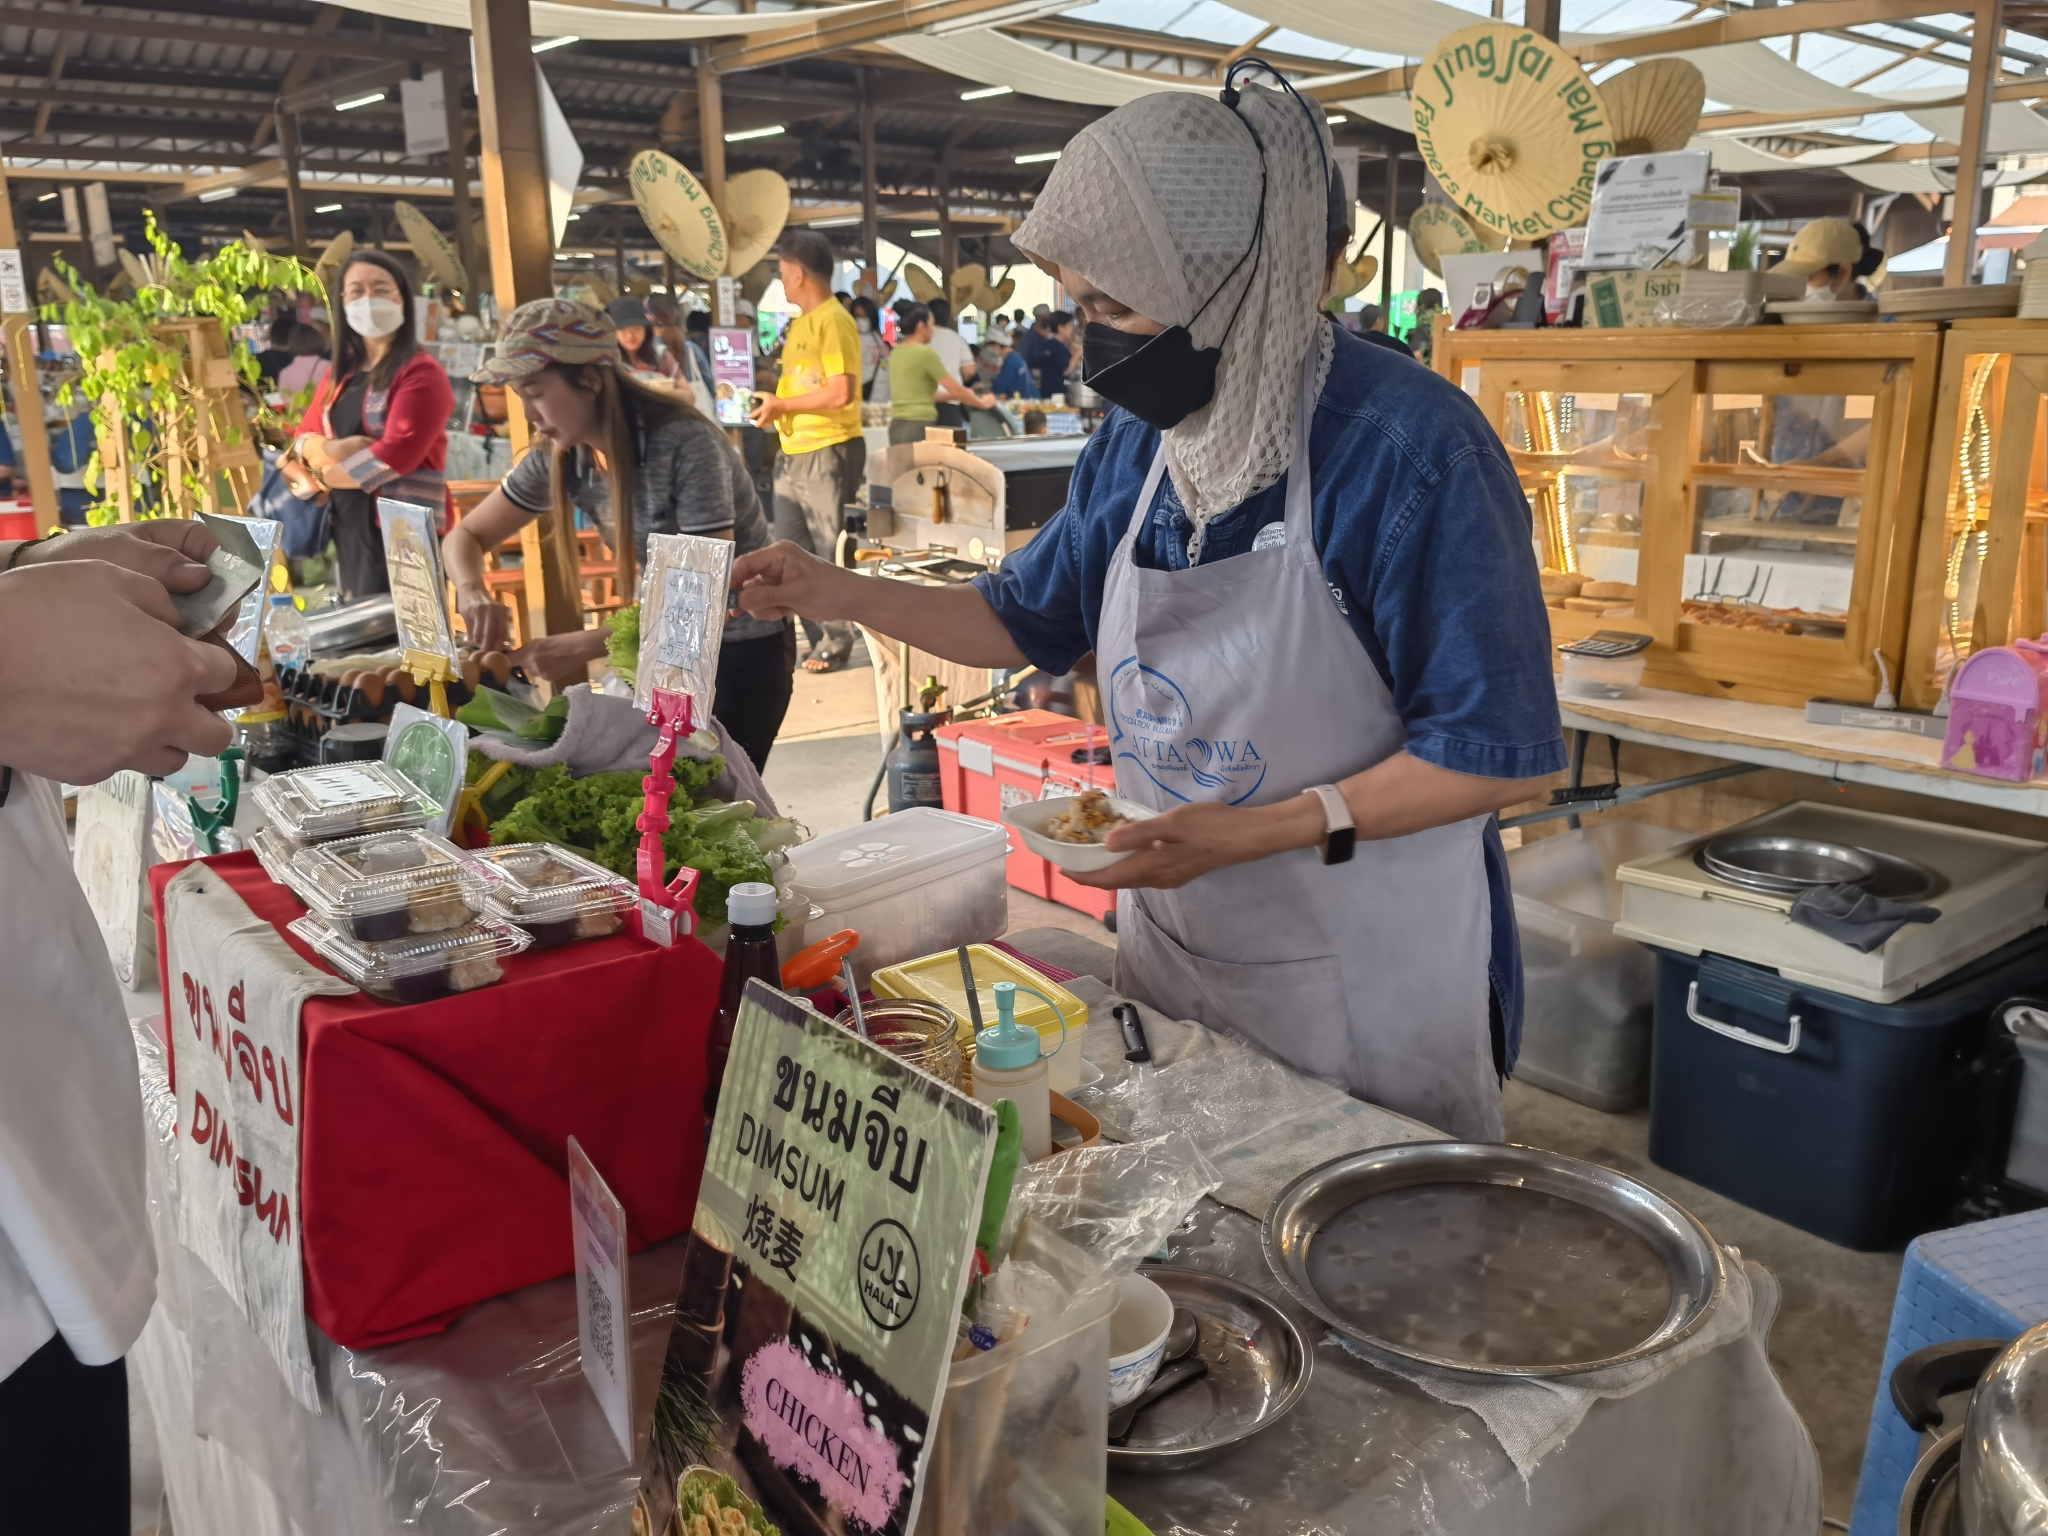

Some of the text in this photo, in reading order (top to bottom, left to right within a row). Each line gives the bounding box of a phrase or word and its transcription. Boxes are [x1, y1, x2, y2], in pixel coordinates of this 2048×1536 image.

[674, 170, 700, 202] Mai
[1414, 76, 1613, 236] Farmers Market Chiang Mai
[735, 1111, 846, 1224] DIMSUM
[772, 1054, 928, 1195] ขนมจีบ
[741, 1194, 805, 1284] 烧麦
[863, 1237, 913, 1301] حلال
[864, 1279, 902, 1320] HALAL
[765, 1378, 873, 1497] CHICKEN
